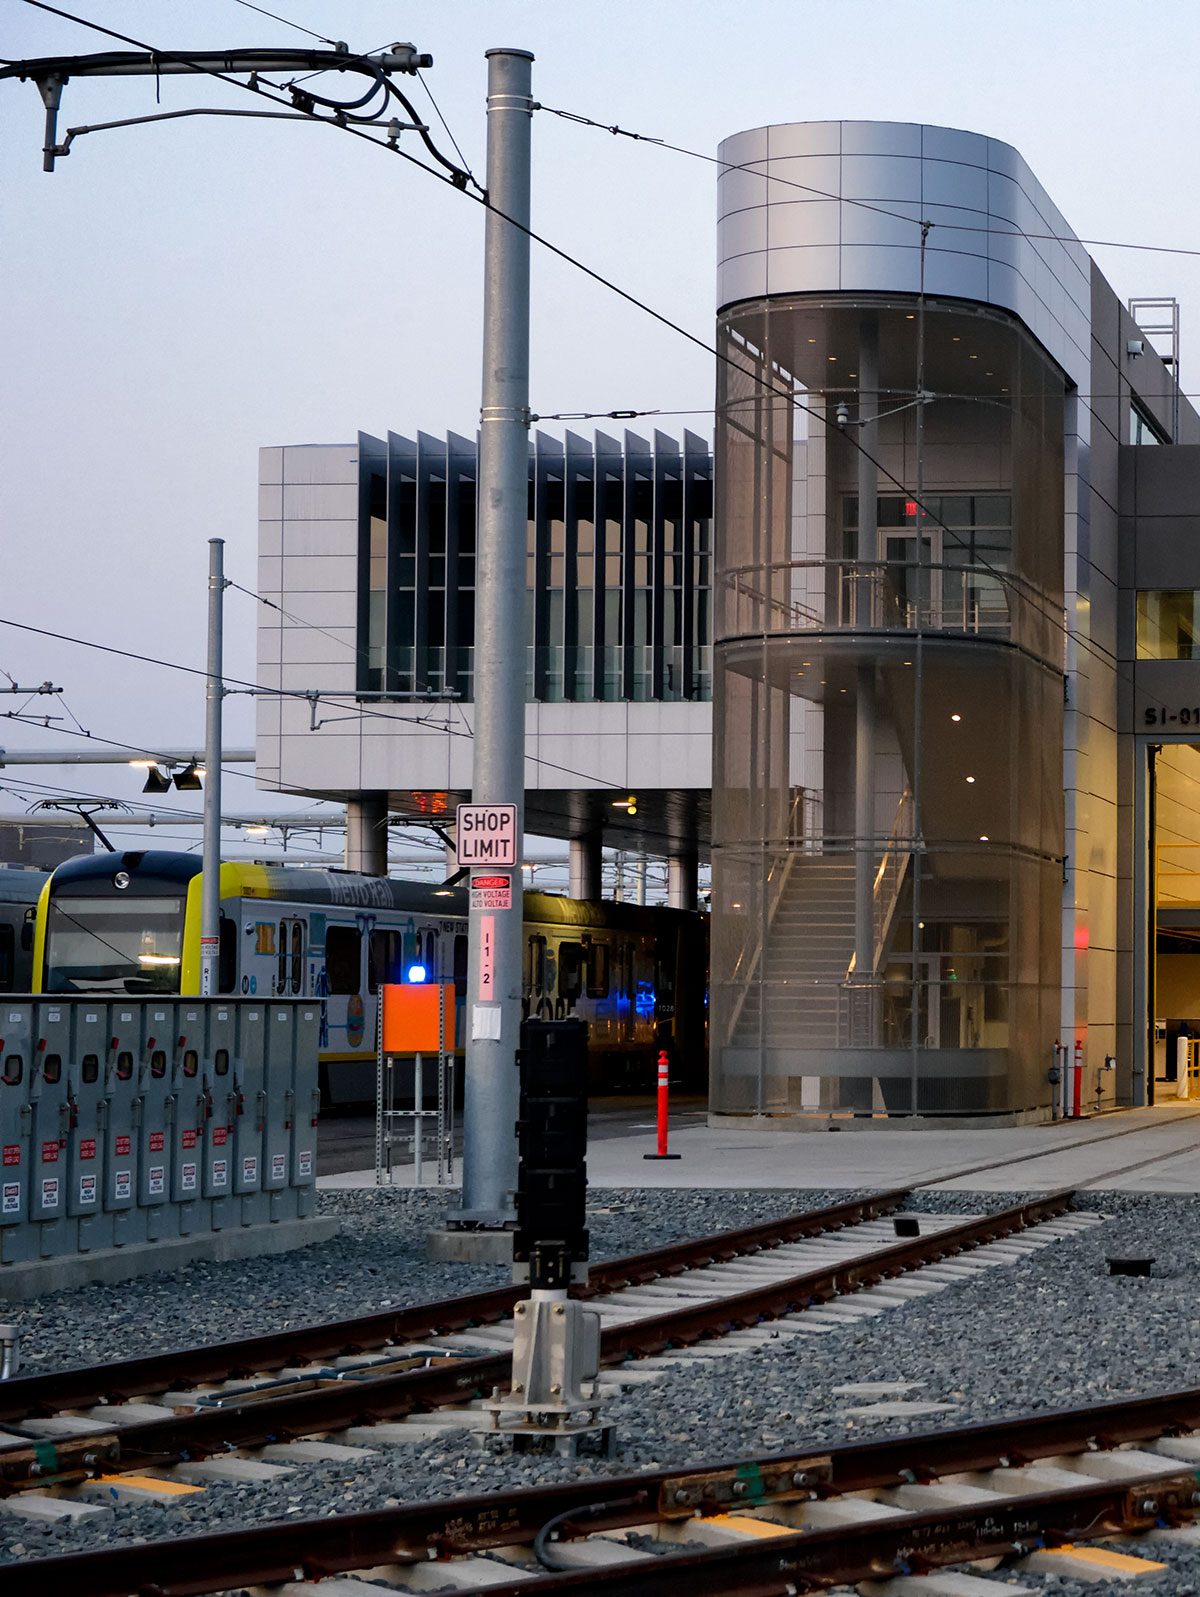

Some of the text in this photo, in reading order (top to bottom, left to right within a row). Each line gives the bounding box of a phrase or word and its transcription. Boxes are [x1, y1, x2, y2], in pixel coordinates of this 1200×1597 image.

[463, 812, 511, 832] SHOP
[463, 839, 511, 858] LIMIT
[475, 879, 504, 887] DANGER
[323, 872, 394, 909] Metro Rail
[483, 890, 510, 898] VOLTAGE
[484, 899, 509, 908] VOLTAJE
